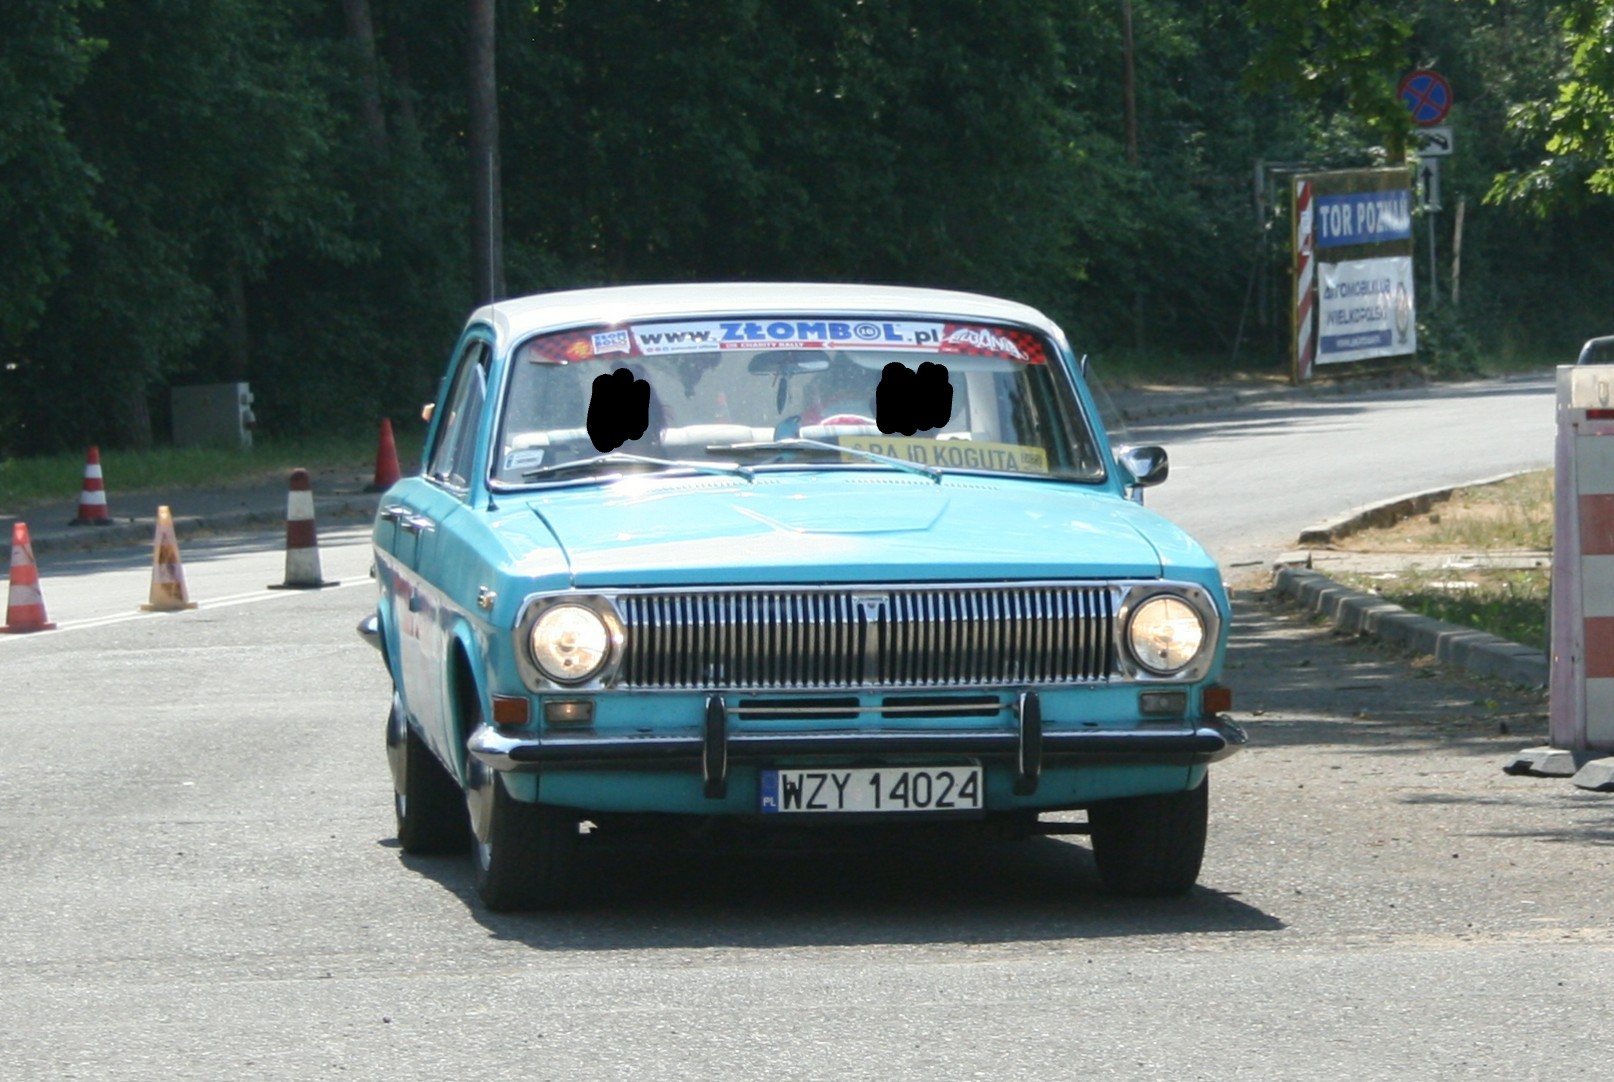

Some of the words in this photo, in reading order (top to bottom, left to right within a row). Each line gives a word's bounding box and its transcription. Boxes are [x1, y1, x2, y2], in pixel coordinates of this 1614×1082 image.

[1320, 204, 1353, 238] TOR
[933, 446, 1018, 471] KOGUTA
[763, 797, 776, 807] PL
[782, 773, 852, 810] WZY
[869, 770, 979, 809] 14024
